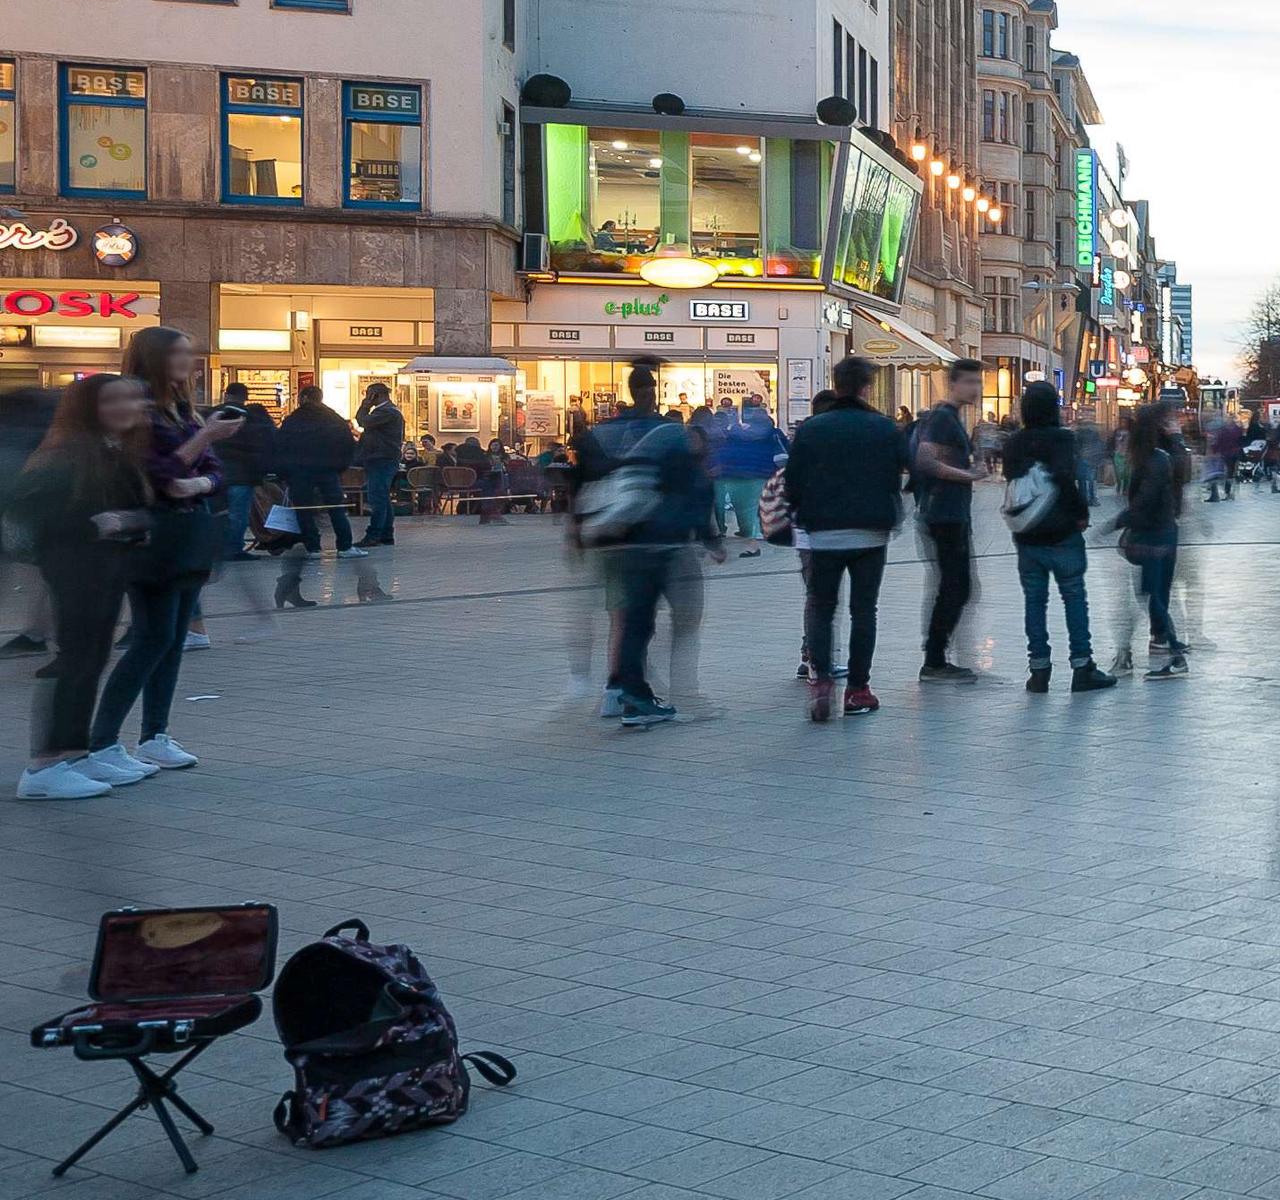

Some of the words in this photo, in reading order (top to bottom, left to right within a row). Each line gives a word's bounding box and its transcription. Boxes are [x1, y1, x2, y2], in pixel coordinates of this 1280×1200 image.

[76, 74, 140, 92] BASE
[236, 84, 293, 102] BASE
[357, 92, 412, 109] BASE
[1077, 154, 1093, 266] DEICHMANN
[695, 302, 744, 318] BASE
[351, 327, 381, 337] BASE
[551, 330, 579, 340] BASE
[646, 332, 673, 342] BASE
[728, 334, 754, 342] BASE
[1090, 361, 1104, 378] U
[718, 372, 731, 380] Die
[718, 380, 746, 388] besten
[718, 386, 749, 395] Stücke!
